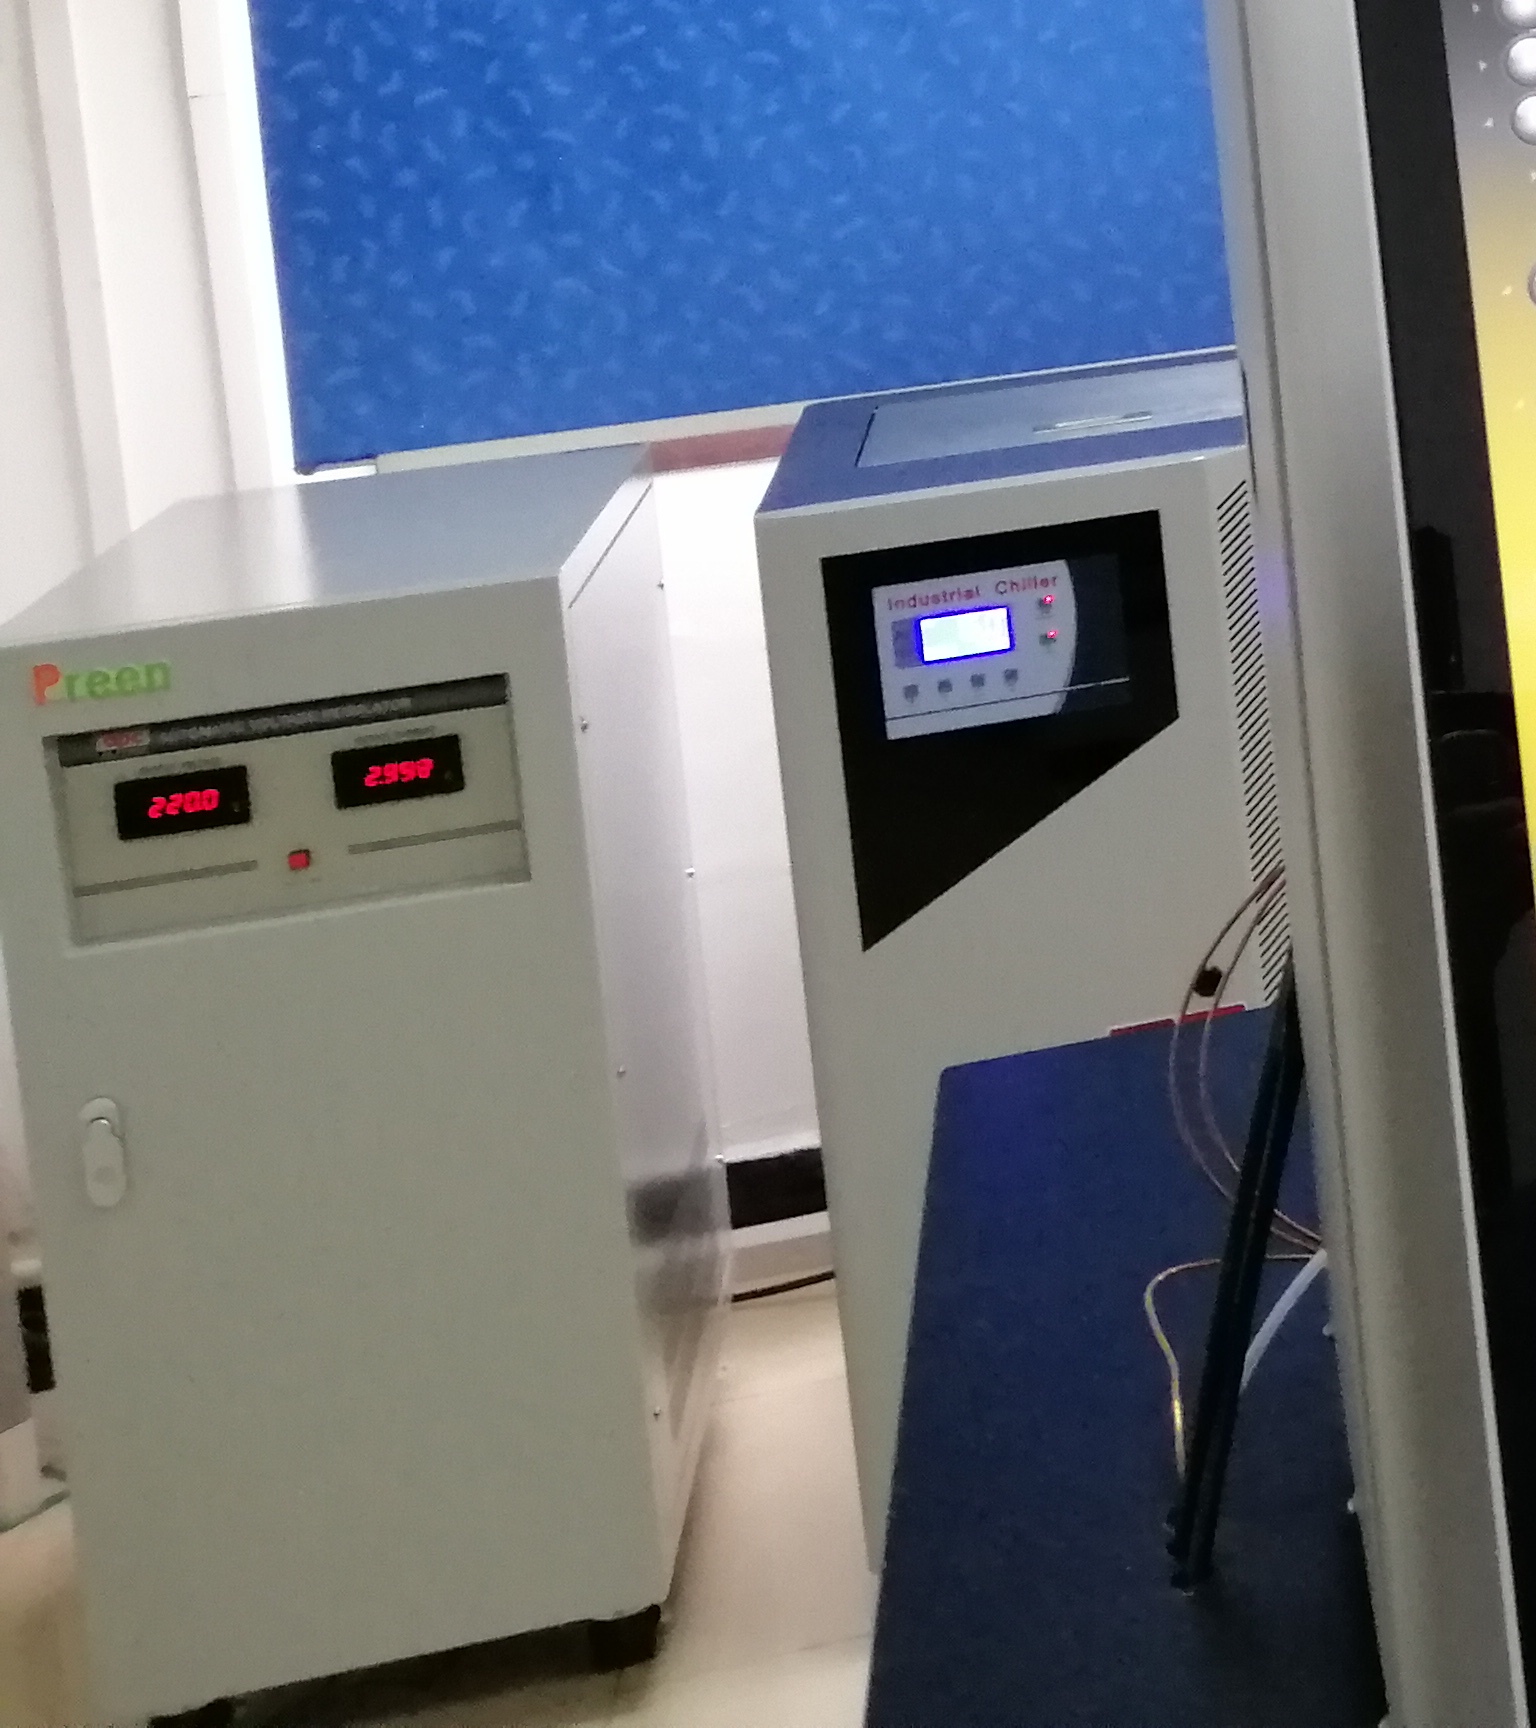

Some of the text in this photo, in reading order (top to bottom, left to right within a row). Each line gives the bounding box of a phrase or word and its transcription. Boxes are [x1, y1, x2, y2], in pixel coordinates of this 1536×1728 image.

[888, 575, 1057, 611] Industrial Chiller
[32, 662, 172, 706] Preen
